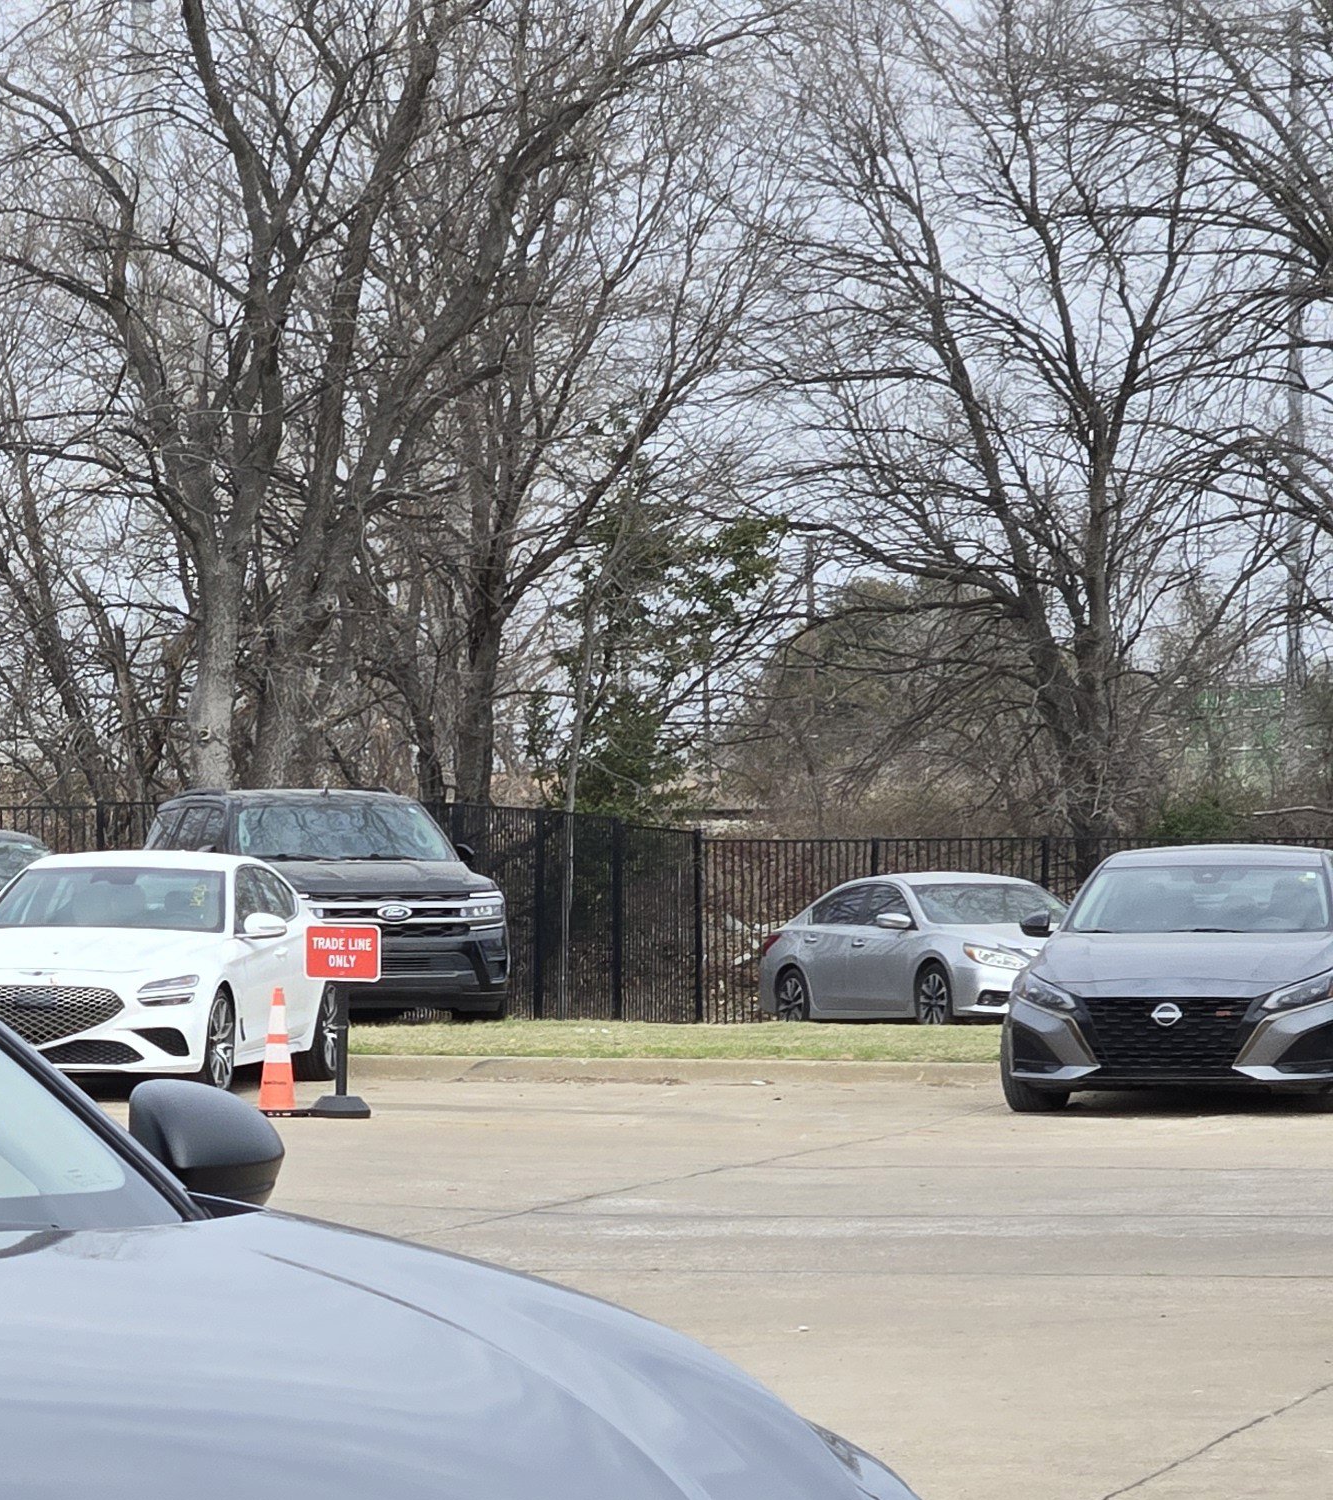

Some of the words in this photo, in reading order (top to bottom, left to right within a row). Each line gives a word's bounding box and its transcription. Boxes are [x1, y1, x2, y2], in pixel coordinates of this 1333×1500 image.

[312, 937, 345, 951] TRADE
[348, 938, 372, 951] LINE
[328, 954, 356, 968] ONLY
